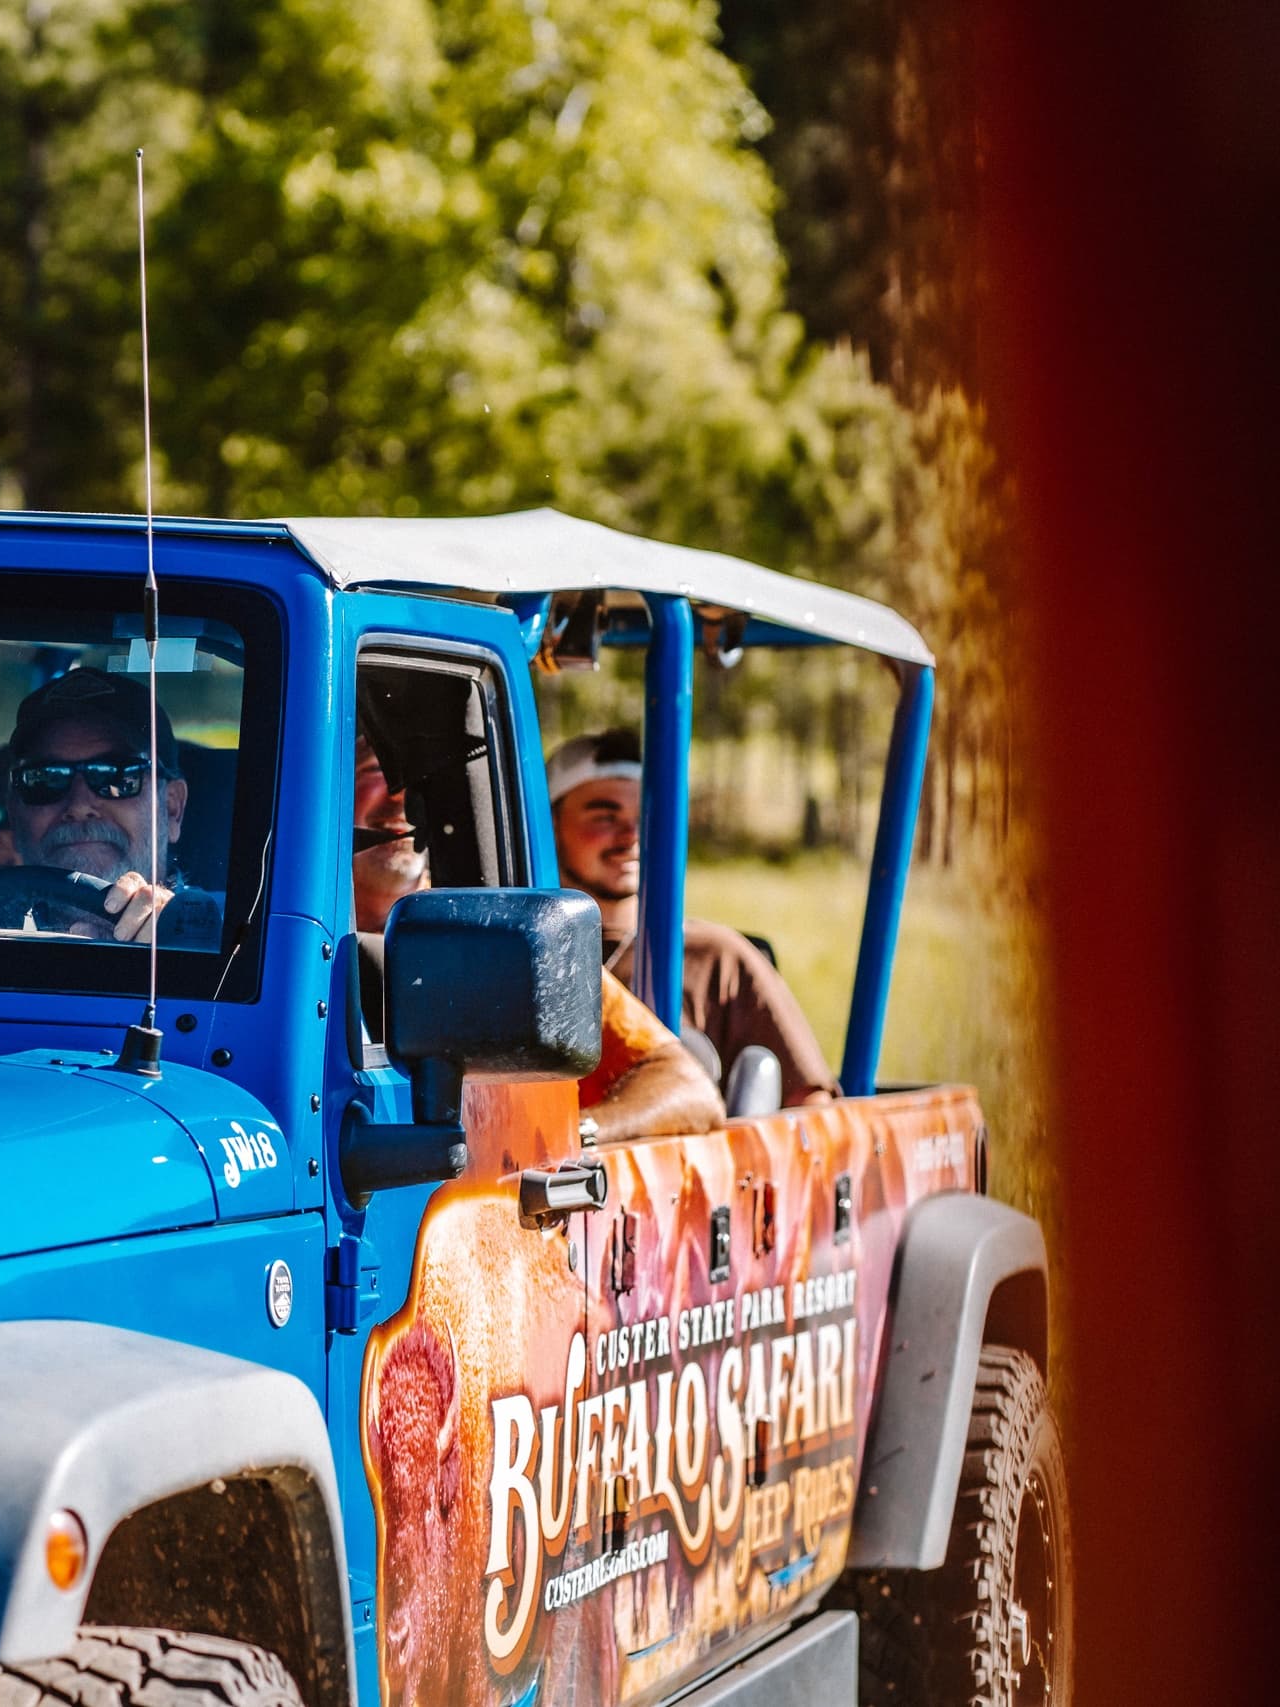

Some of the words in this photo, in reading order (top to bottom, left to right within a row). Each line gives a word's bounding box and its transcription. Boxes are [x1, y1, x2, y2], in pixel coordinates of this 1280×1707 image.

[219, 1121, 278, 1188] JW18
[596, 1316, 670, 1376] CUSTER
[678, 1299, 735, 1351] STATE
[741, 1285, 786, 1332] PARK
[793, 1269, 857, 1320] RESORT
[484, 1331, 711, 1659] BUFFALO
[711, 1317, 857, 1533] SAFARI
[734, 1480, 791, 1586] JEEP
[793, 1456, 855, 1556] RIDES
